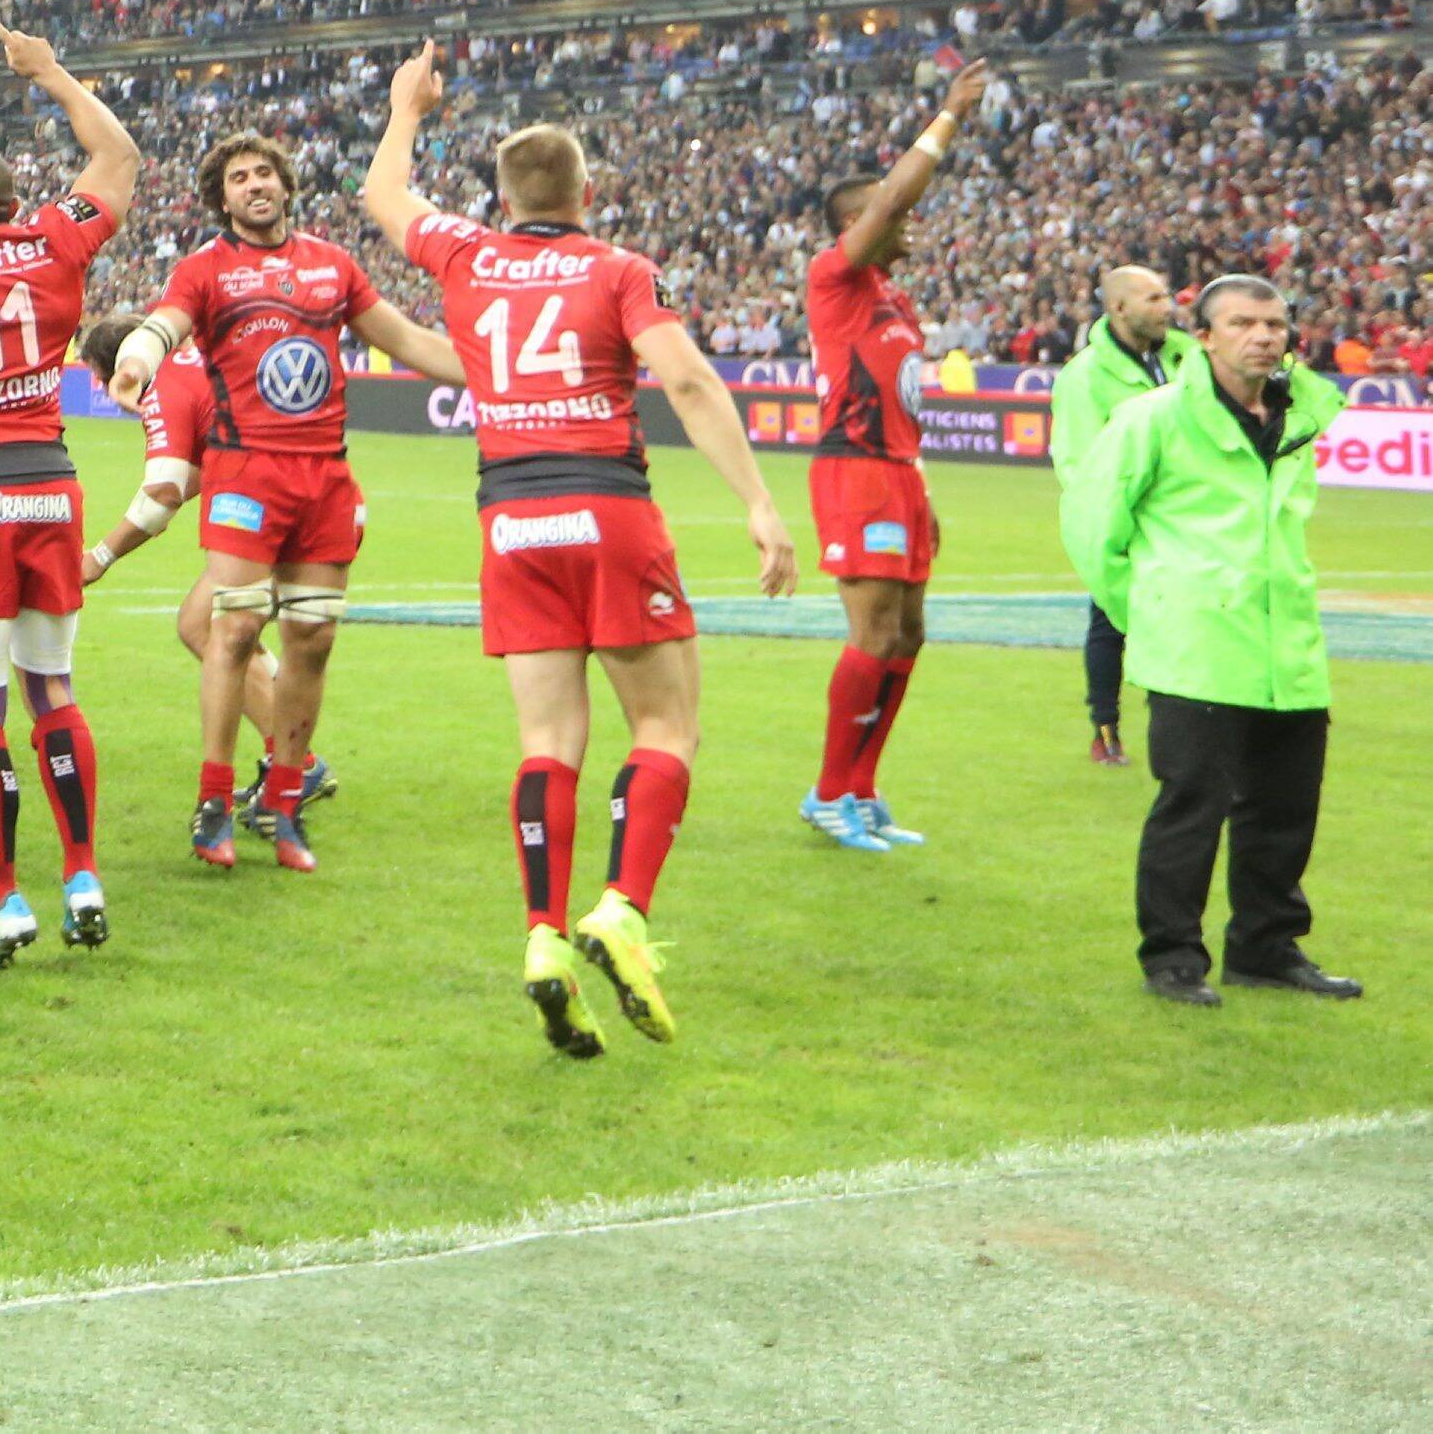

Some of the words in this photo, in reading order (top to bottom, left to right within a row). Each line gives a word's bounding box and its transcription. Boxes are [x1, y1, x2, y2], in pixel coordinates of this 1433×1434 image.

[471, 245, 595, 279] Crafter
[474, 294, 583, 394] 14
[141, 388, 168, 450] TEAM
[428, 386, 477, 428] CA
[919, 432, 997, 452] ALISTES
[494, 511, 599, 552] ORANGINA
